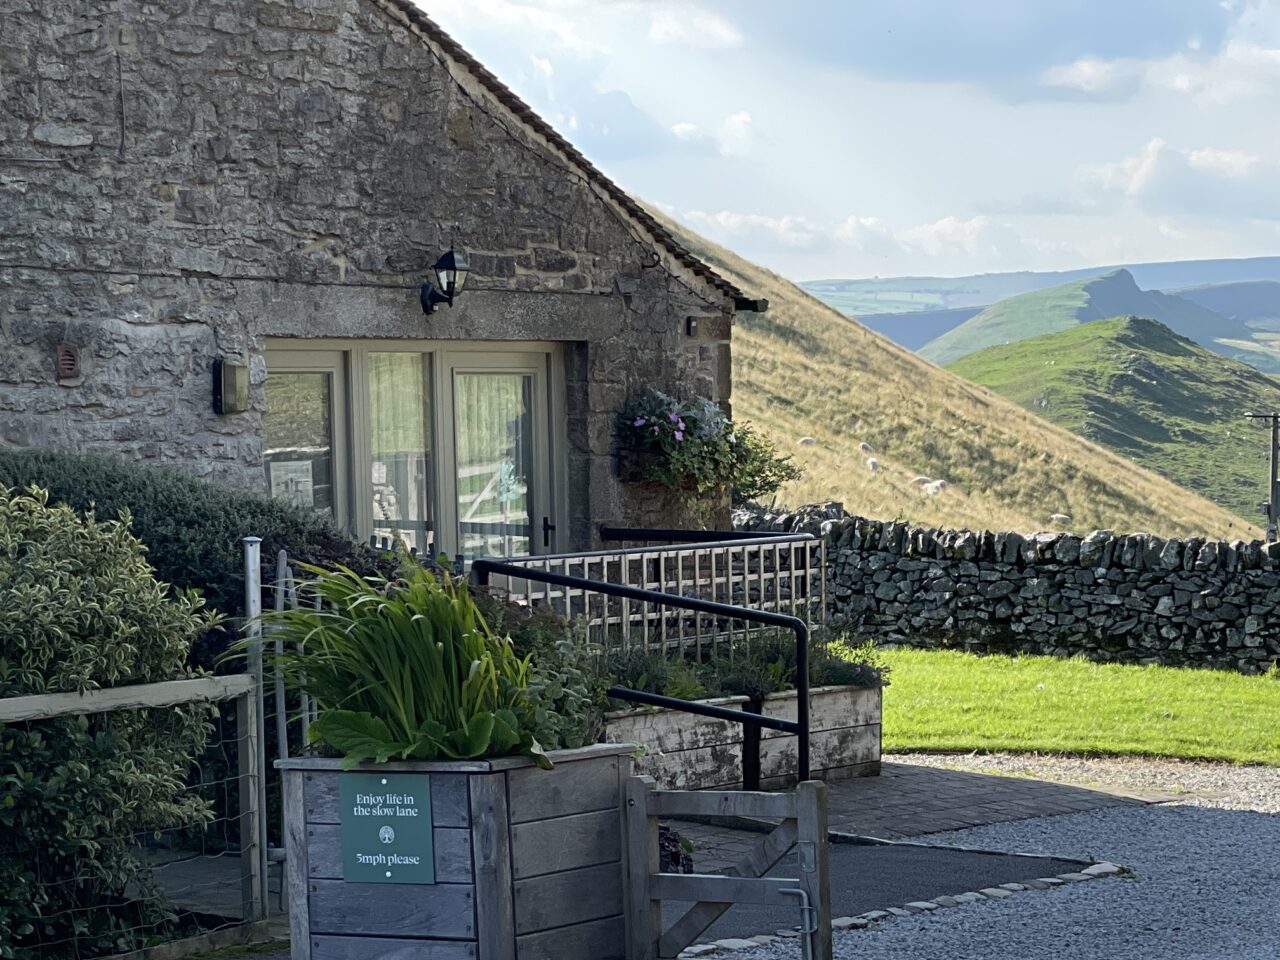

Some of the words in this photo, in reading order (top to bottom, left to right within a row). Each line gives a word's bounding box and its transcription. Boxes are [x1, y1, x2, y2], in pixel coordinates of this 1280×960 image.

[356, 793, 386, 806] Enjoy
[386, 793, 403, 804] life
[403, 793, 415, 805] in
[353, 806, 371, 816] the
[371, 805, 395, 817] slow
[396, 806, 418, 817] lane
[356, 853, 386, 866] 5mph
[387, 853, 420, 867] please
